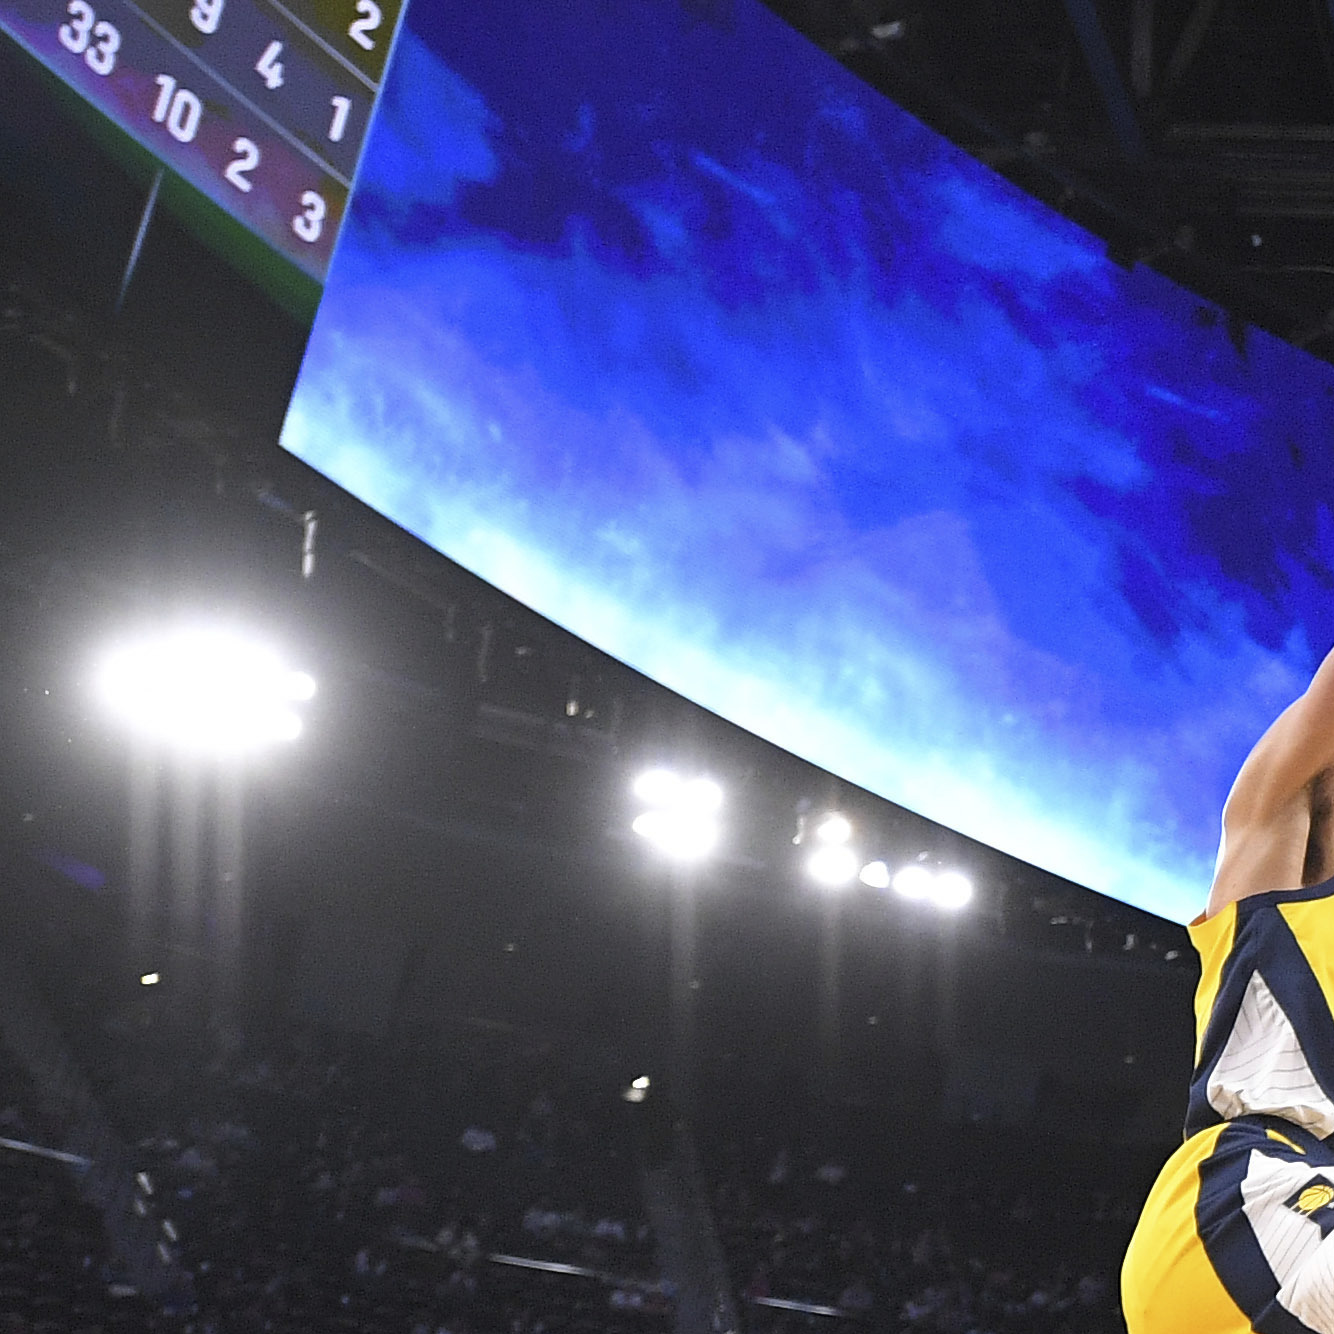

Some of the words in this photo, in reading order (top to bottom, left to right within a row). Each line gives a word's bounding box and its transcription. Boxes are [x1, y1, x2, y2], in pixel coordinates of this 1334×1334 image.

[348, 0, 382, 50] 2
[58, 0, 121, 75] 33
[152, 74, 202, 143] 10
[224, 137, 260, 193] 2
[292, 190, 326, 243] 3
[255, 41, 284, 89] 4
[328, 96, 351, 142] 1
